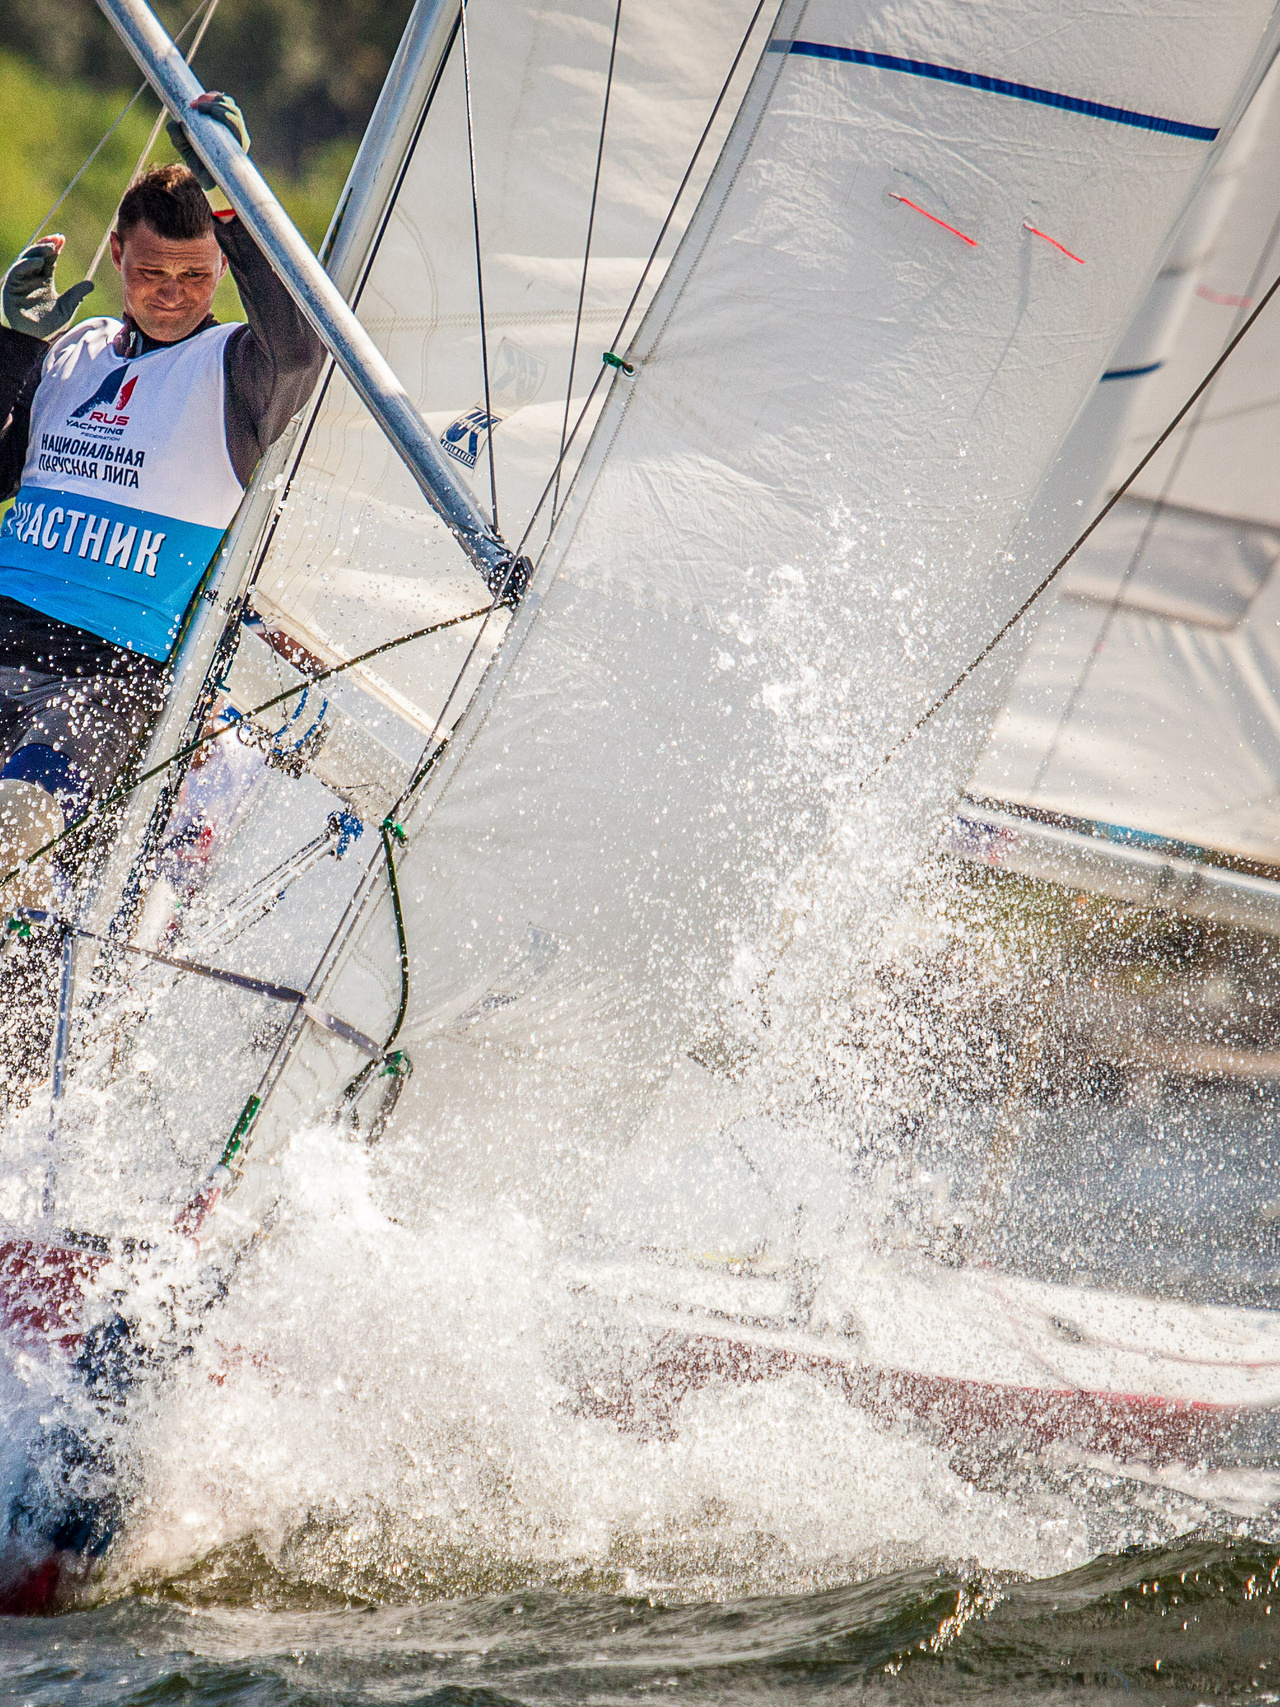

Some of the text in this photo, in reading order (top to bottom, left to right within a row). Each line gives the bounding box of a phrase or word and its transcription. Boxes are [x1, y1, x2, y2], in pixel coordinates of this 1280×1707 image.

[89, 411, 130, 426] RUS
[66, 419, 124, 435] YACHTING
[80, 431, 120, 442] FEDERATION
[41, 433, 145, 468] НАЦИОНАЛЬНАЯ
[38, 453, 139, 489] ПАРУСНАЯ ЛИГА
